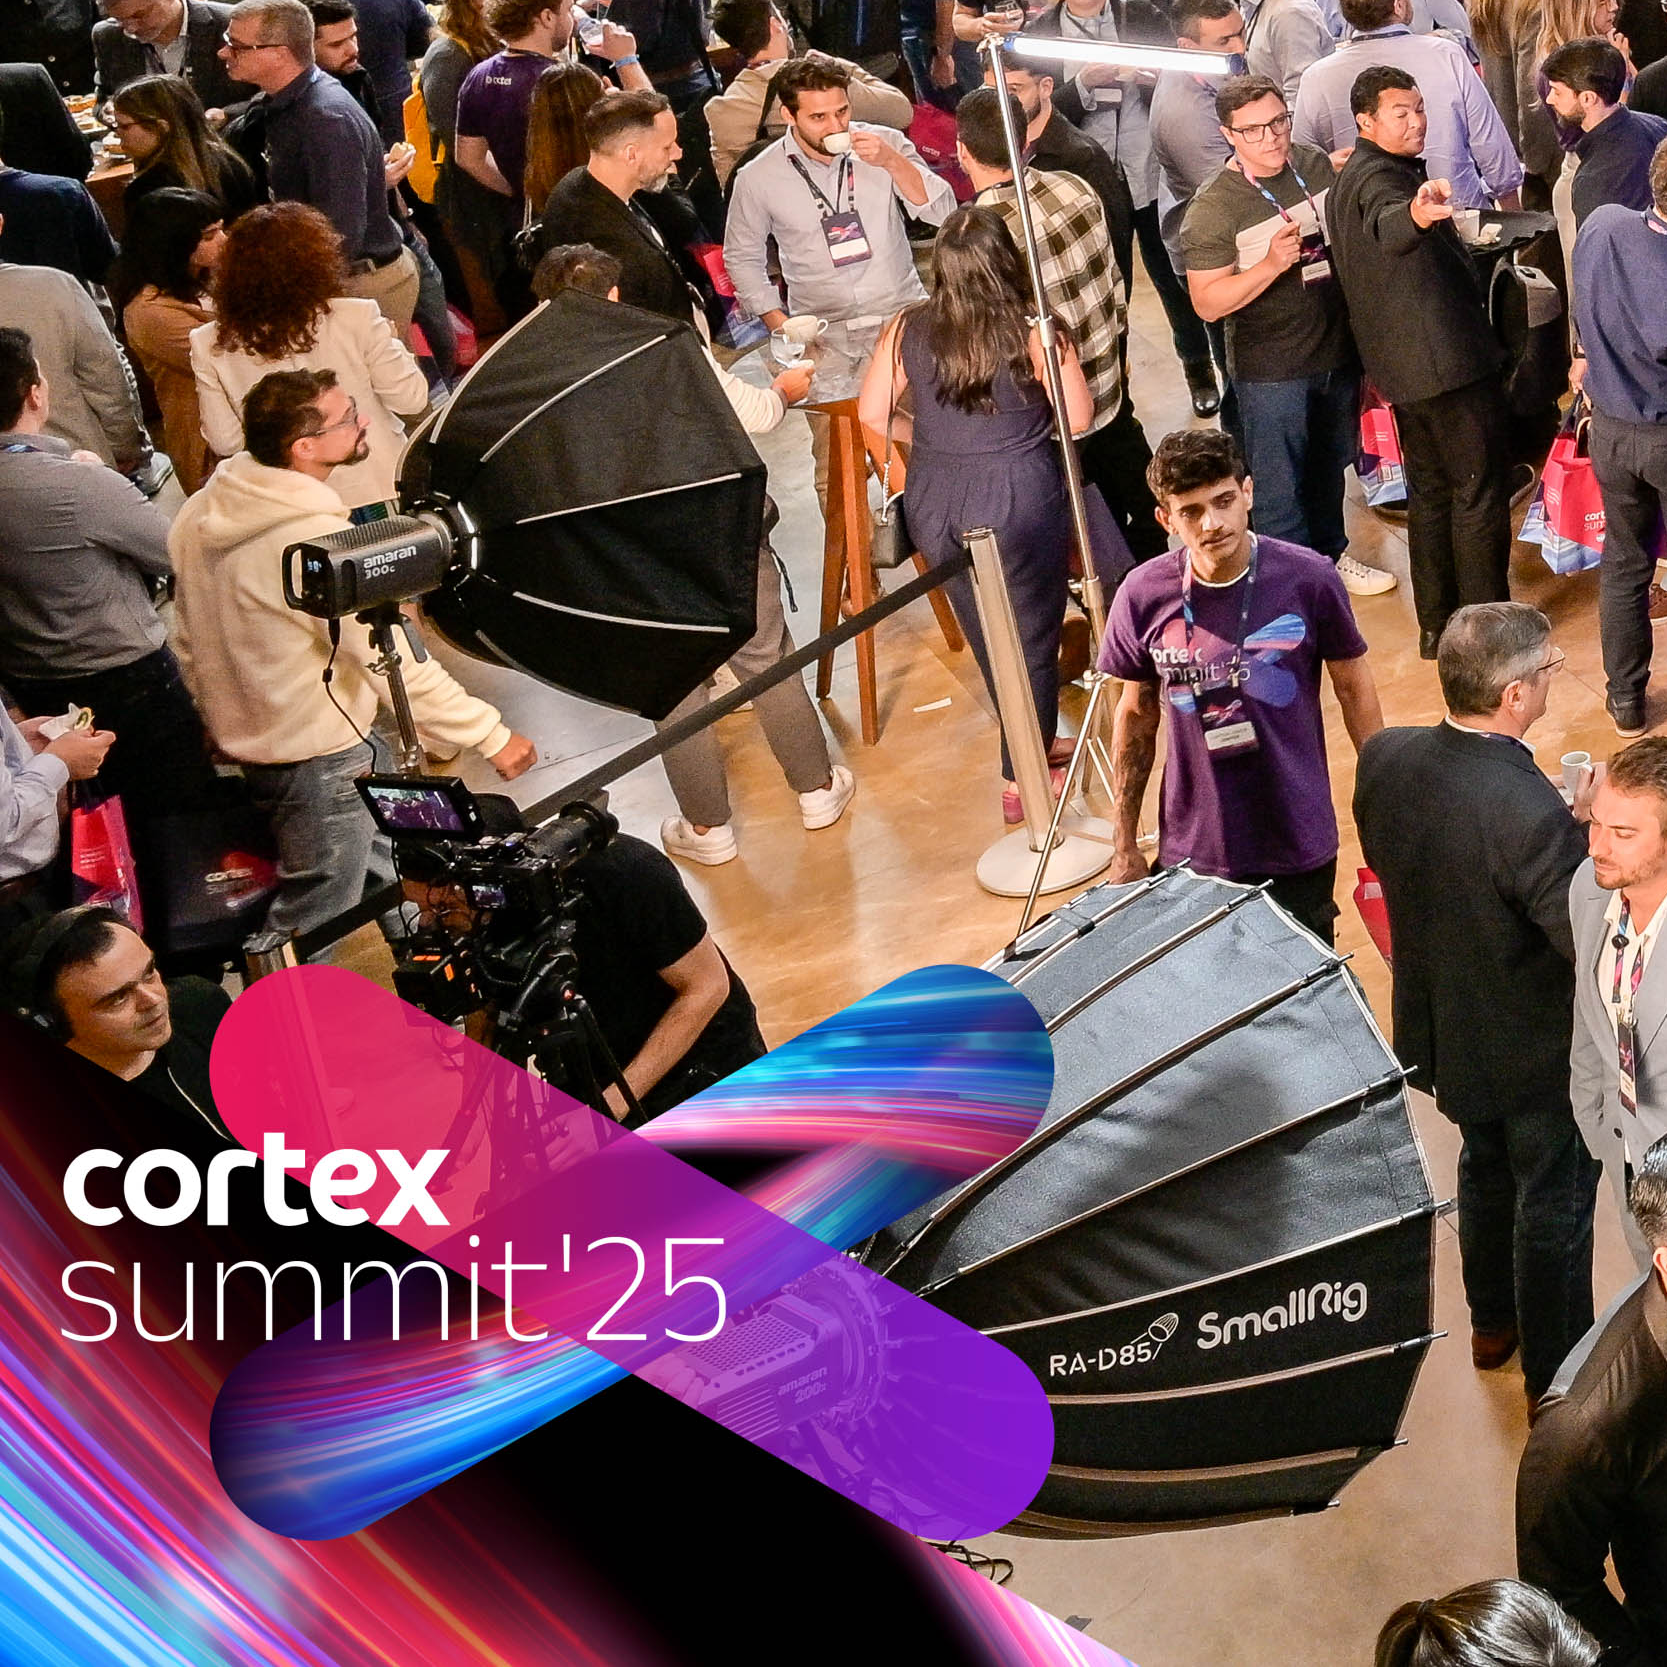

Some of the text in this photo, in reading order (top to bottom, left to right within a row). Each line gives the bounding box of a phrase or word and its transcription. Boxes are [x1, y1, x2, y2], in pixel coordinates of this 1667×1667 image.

[1584, 510, 1605, 522] cort
[363, 545, 417, 569] amaran
[365, 565, 395, 580] 300c
[1149, 646, 1201, 664] orte
[1197, 1281, 1367, 1349] SmallRig
[1049, 1342, 1152, 1376] RA-D85
